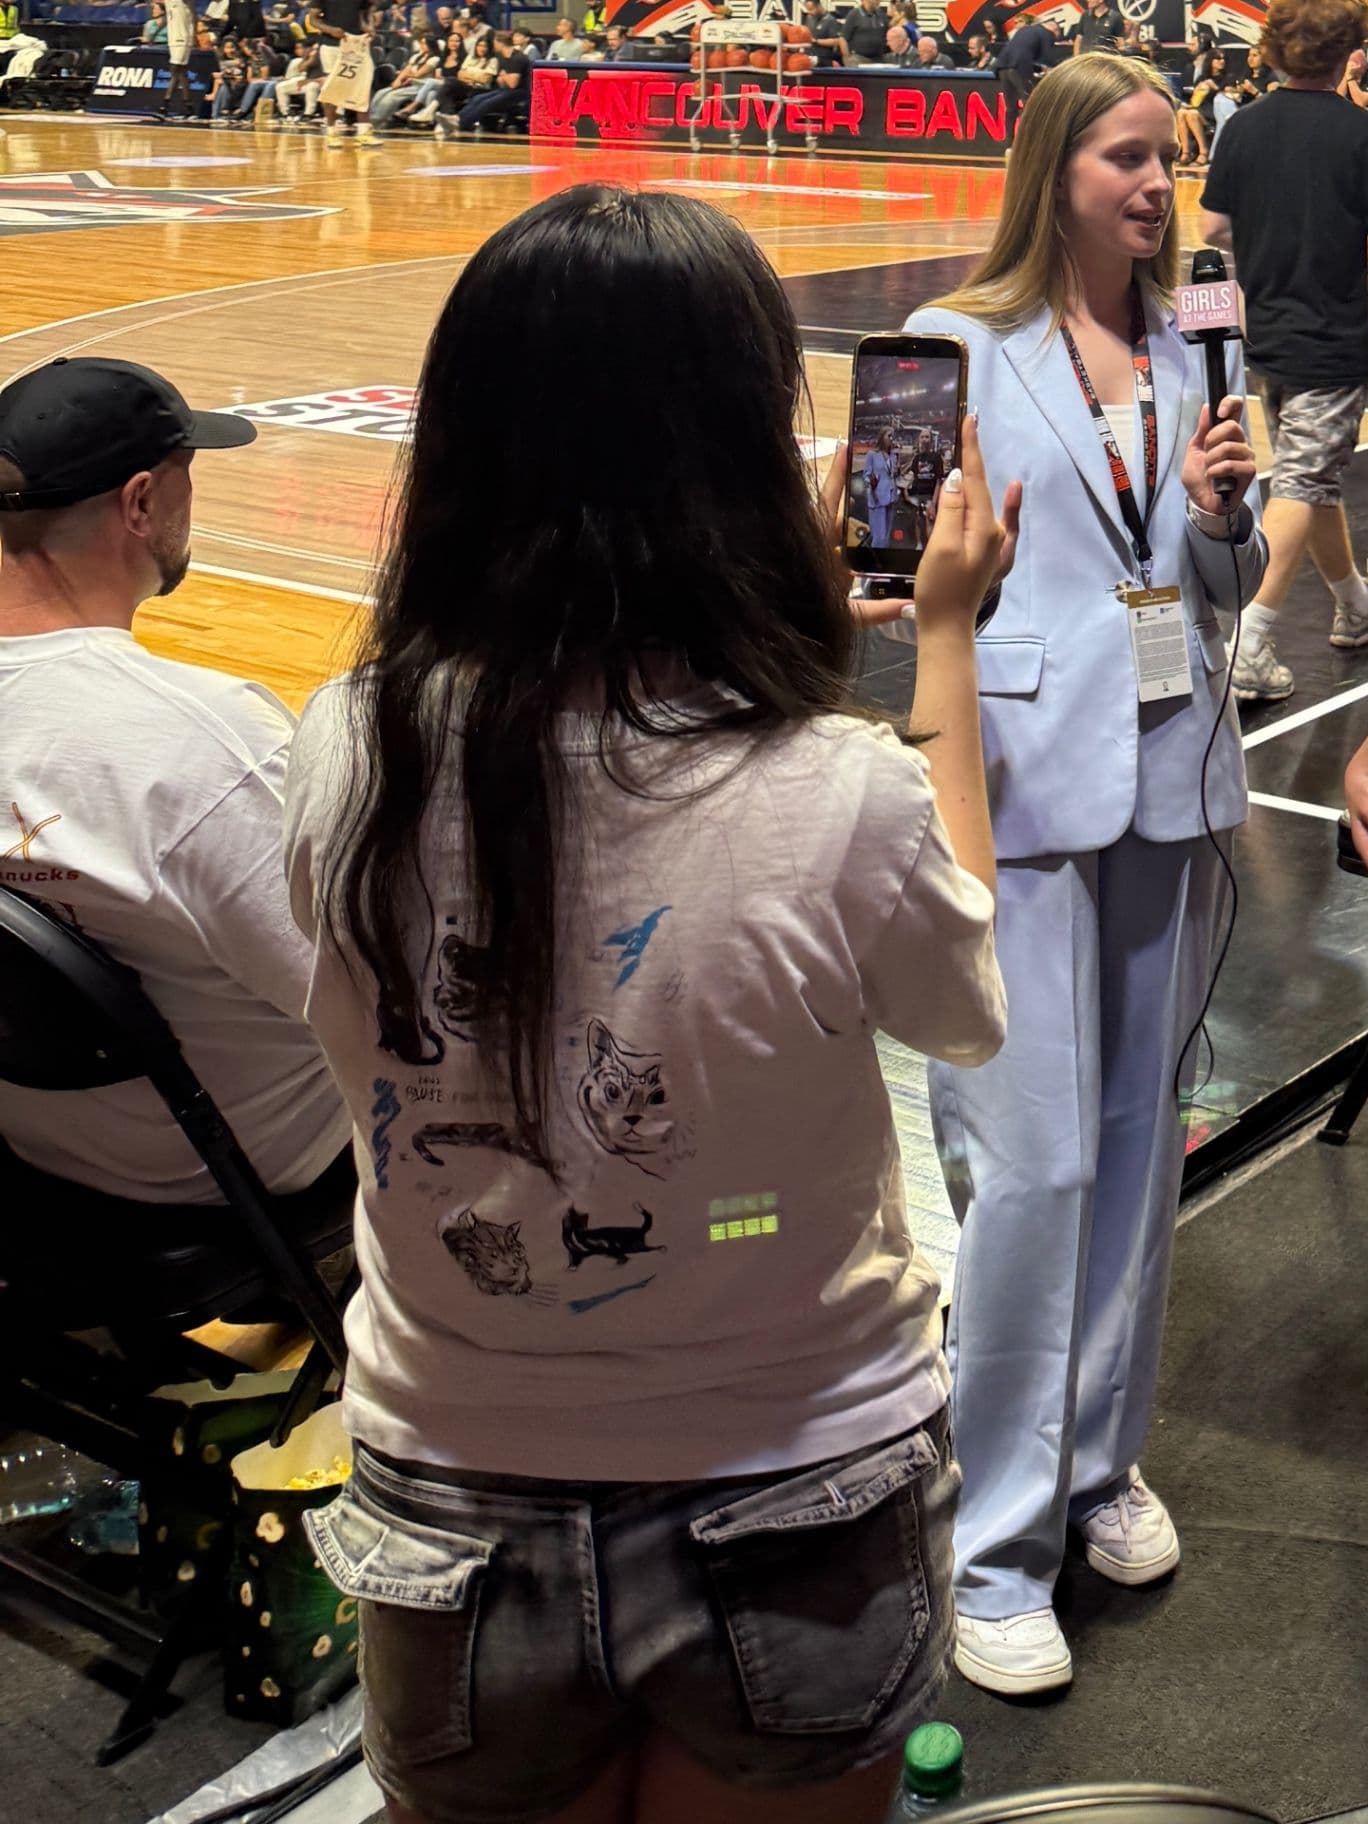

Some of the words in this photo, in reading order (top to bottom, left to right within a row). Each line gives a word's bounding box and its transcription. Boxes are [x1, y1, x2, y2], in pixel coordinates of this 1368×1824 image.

[97, 66, 154, 88] RONA
[337, 63, 358, 79] 25
[1181, 287, 1231, 313] GIRLS
[0, 868, 79, 882] nucks
